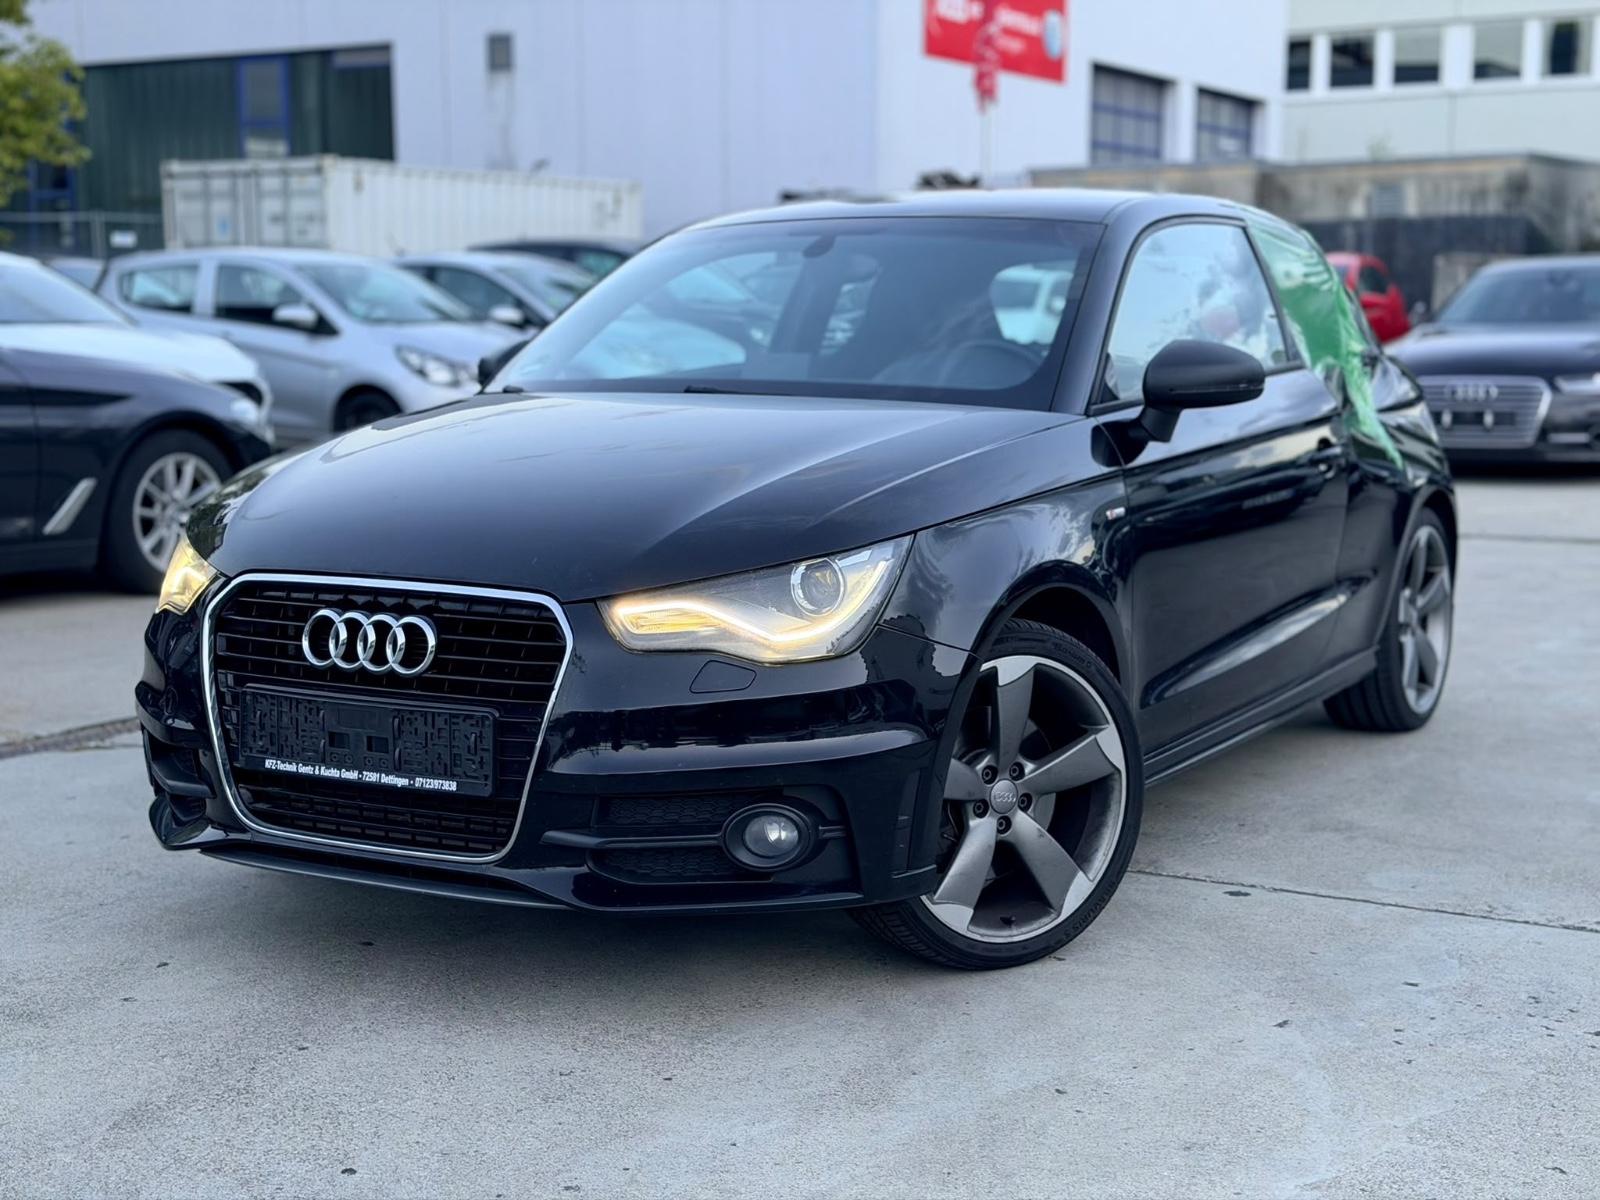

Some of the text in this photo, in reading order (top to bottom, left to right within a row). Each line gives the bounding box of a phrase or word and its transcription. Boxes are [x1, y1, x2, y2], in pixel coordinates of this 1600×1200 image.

[264, 758, 297, 772] KFZ-Technik
[298, 763, 314, 774] Gentz
[314, 765, 320, 775] &
[320, 766, 340, 778] Kuchta
[341, 769, 359, 780] GmbH
[381, 773, 409, 787] Dettingen
